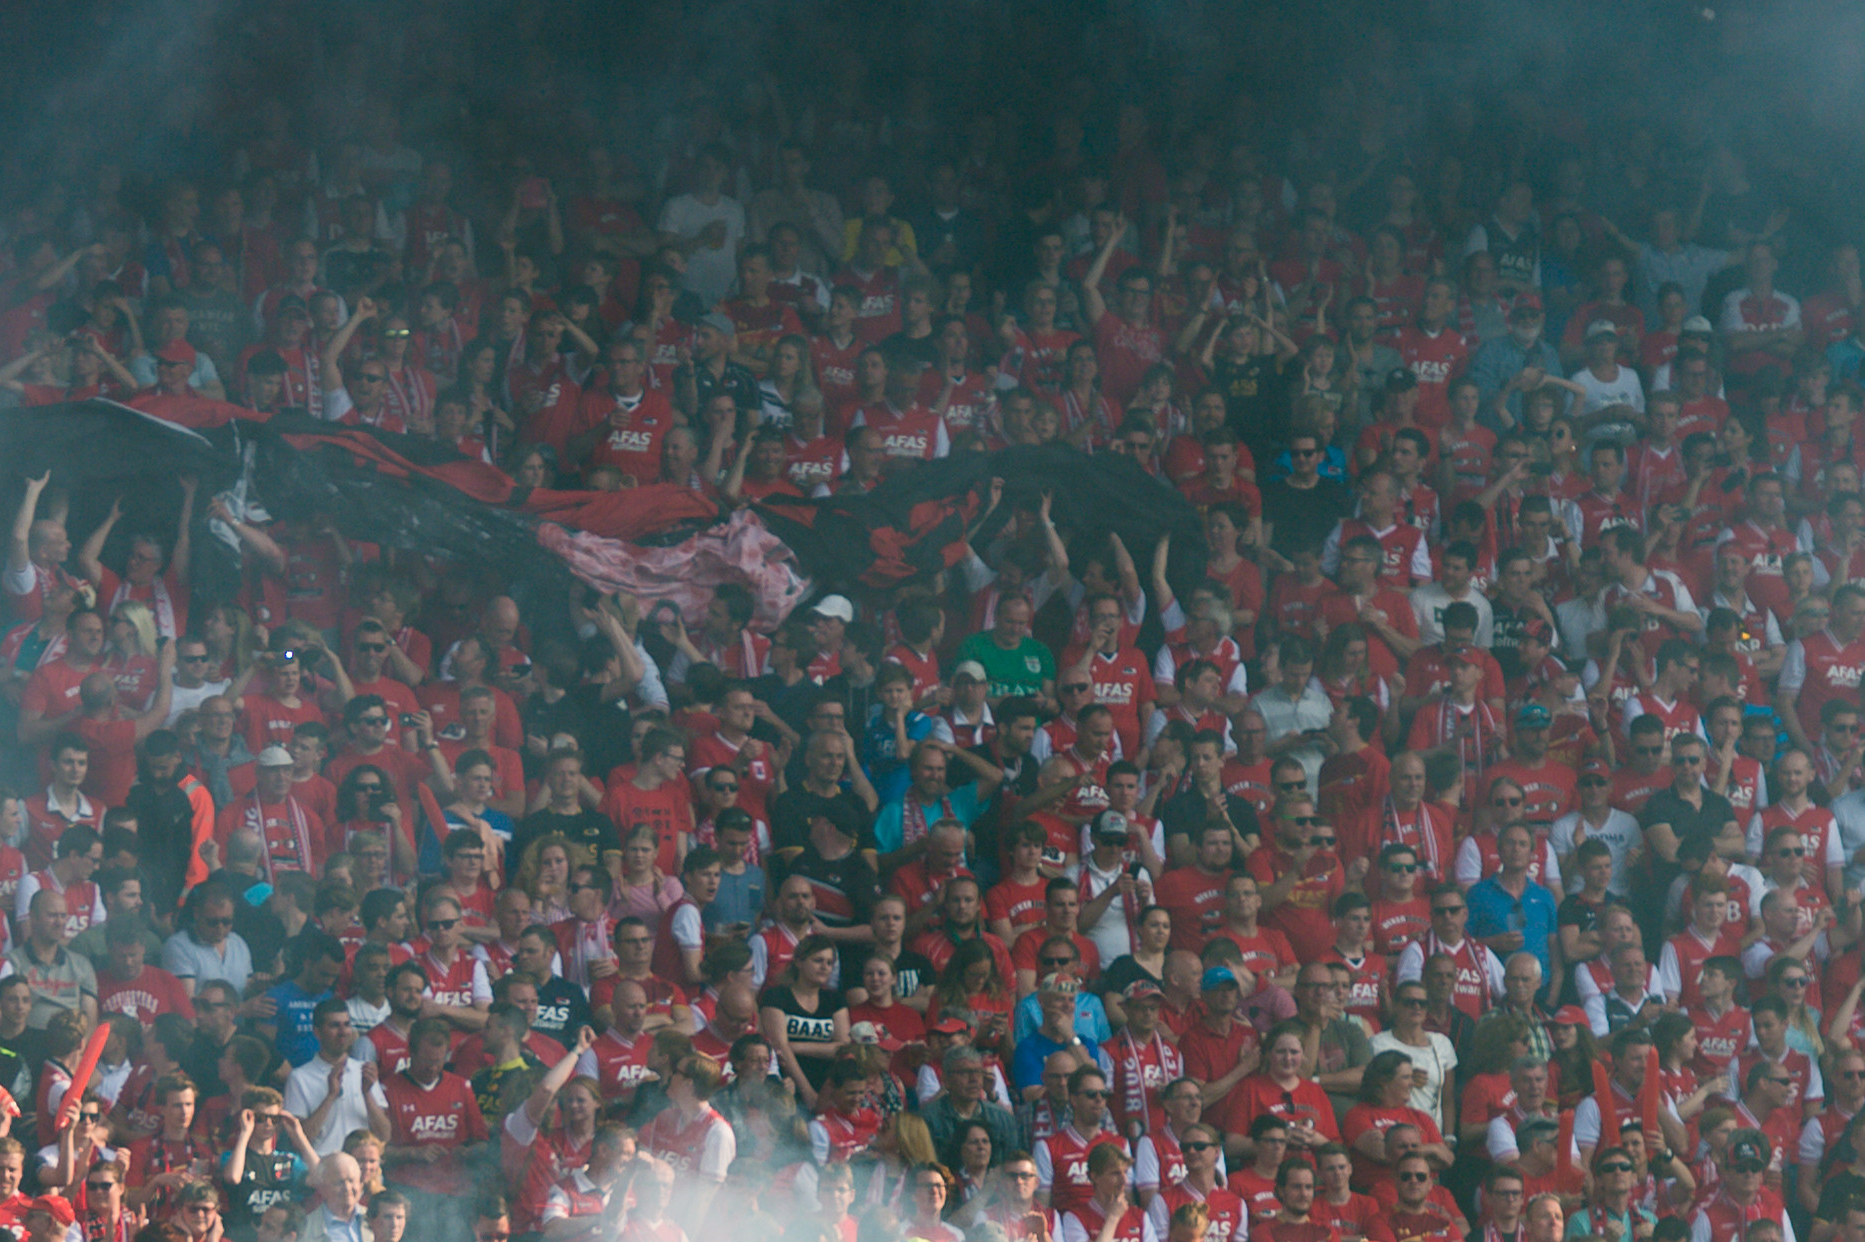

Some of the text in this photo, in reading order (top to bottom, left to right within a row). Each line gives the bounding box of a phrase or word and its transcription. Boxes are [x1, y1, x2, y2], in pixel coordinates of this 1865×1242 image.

[1410, 361, 1451, 377] AFAS
[946, 405, 973, 418] AFA
[607, 430, 652, 446] AFAS
[885, 435, 927, 450] AFAS
[789, 462, 834, 477] AFAS
[1076, 786, 1110, 800] AFA
[535, 1004, 570, 1022] FAS
[788, 1018, 833, 1038] BAAS
[1700, 1037, 1737, 1051] AFAS
[617, 1065, 648, 1081] AFA
[411, 1115, 458, 1132] AFAS
